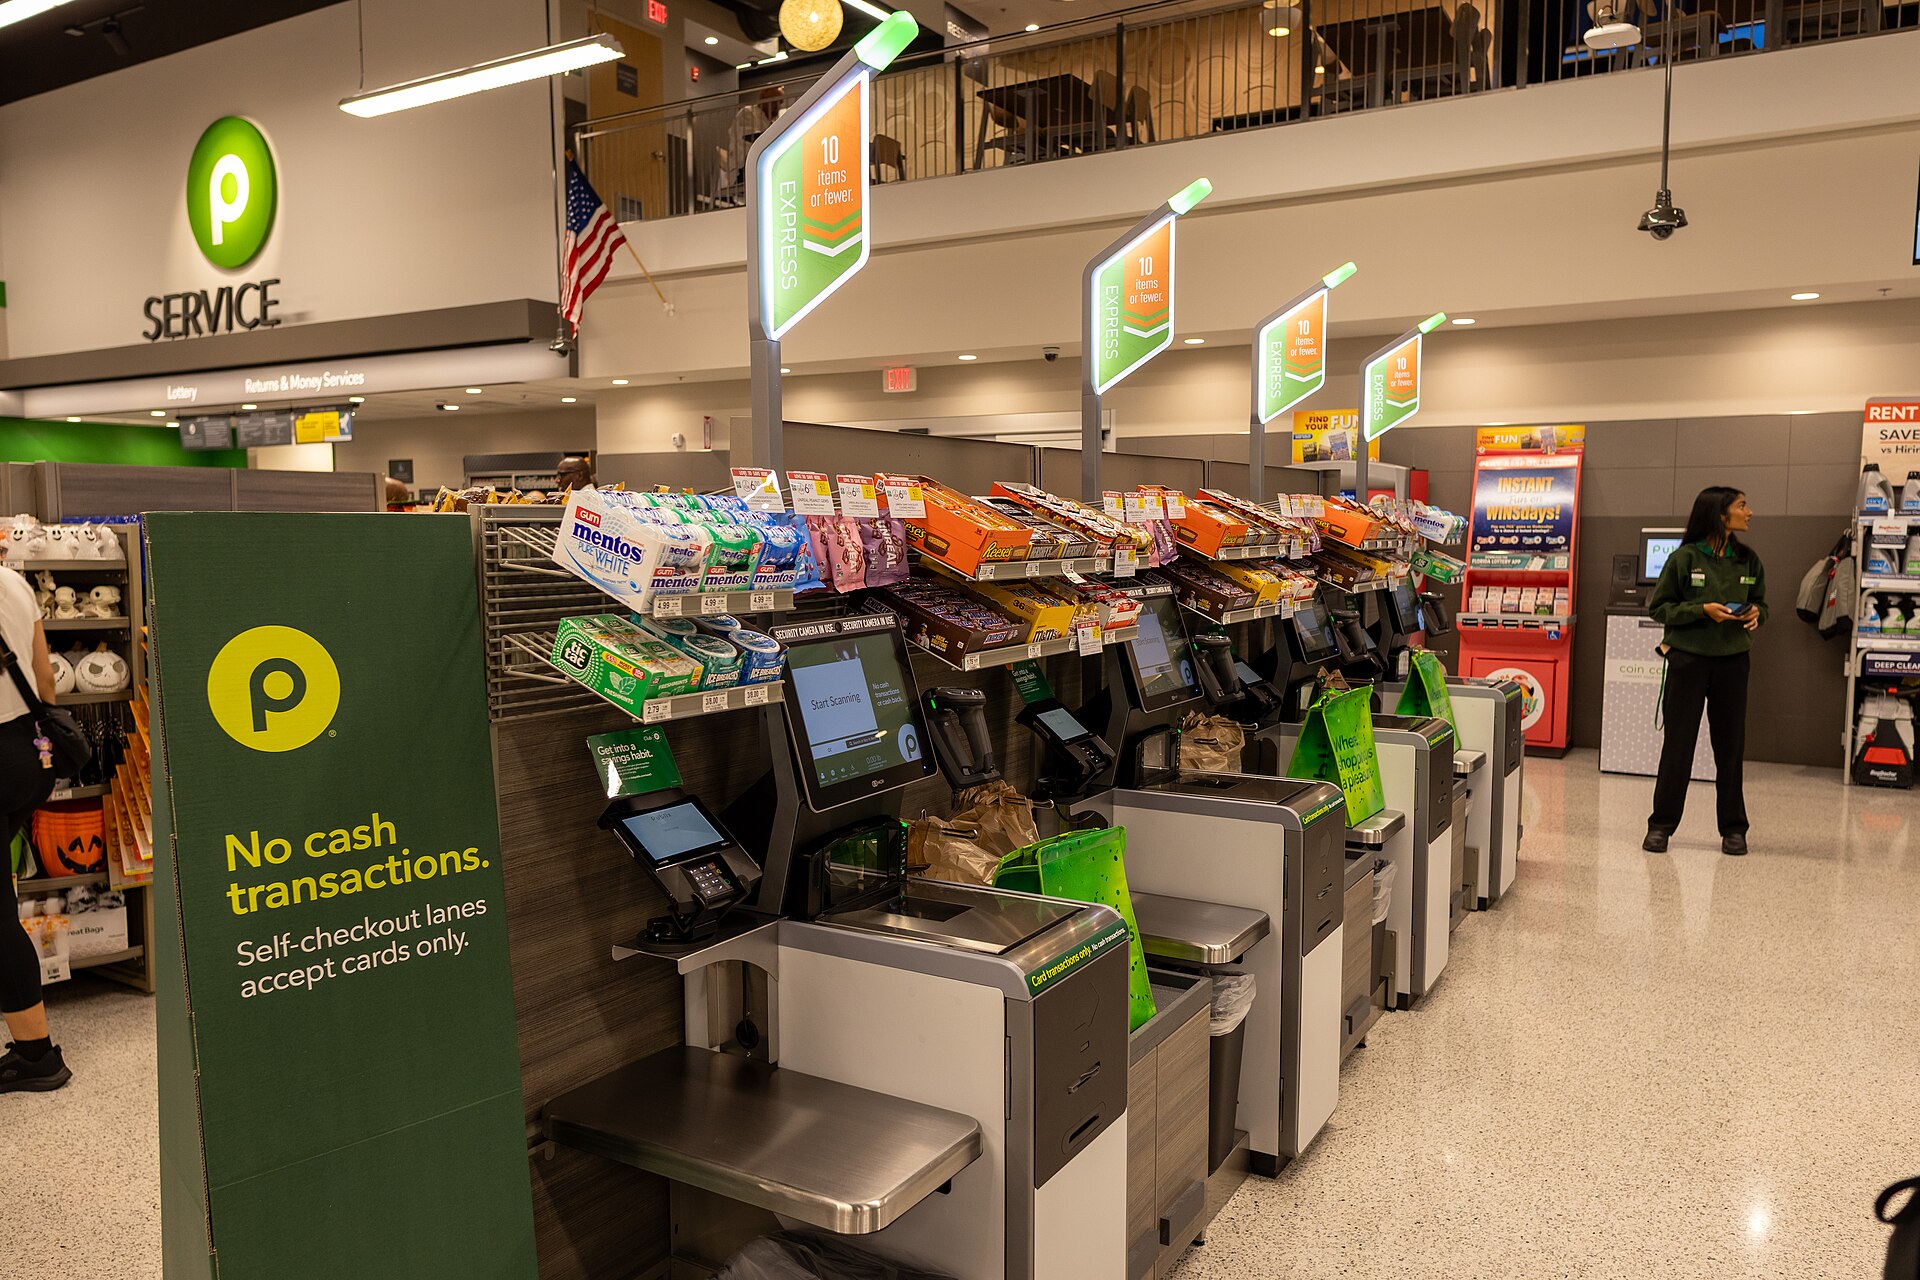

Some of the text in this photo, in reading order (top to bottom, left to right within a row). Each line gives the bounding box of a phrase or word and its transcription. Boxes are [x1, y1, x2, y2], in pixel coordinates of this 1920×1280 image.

[821, 136, 839, 165] 10
[817, 168, 847, 187] items
[810, 187, 854, 207] or fewer.
[779, 180, 797, 290] EXPRESS
[1138, 256, 1153, 277] 10
[1135, 278, 1158, 291] items
[1129, 291, 1164, 305] or fewer.
[142, 278, 281, 341] SERVICE
[1105, 285, 1119, 360] EXPRESS
[1298, 319, 1310, 336] 10
[1295, 336, 1314, 347] items
[1290, 345, 1318, 357] or fewer.
[1270, 341, 1283, 399] EXPRESS
[1396, 357, 1407, 370] 10
[245, 370, 365, 394] Returns & Money Services
[887, 367, 911, 391] EXIT
[1394, 370, 1410, 379] items
[167, 385, 198, 402] Lottery
[1373, 374, 1384, 421] EXPRESS
[1309, 415, 1329, 424] FIND
[1869, 406, 1919, 420] RENT
[1494, 434, 1518, 444] FUN
[1880, 429, 1920, 440] SAVE
[1497, 477, 1554, 494] INSTANT
[1486, 504, 1561, 524] WINSdays!
[1414, 516, 1445, 529] mentos
[572, 522, 642, 562] mentos
[877, 520, 897, 569] UNREAL
[981, 541, 1014, 559] Reese's
[578, 541, 630, 577] PURE WHITE
[651, 576, 699, 588] mentos
[704, 574, 749, 586] mentos
[754, 573, 795, 584] mentos
[657, 601, 670, 610] 4.99
[704, 598, 717, 607] 4.99
[753, 595, 765, 604] 4.99
[1012, 599, 1026, 611] 36
[843, 619, 863, 631] SECURITY
[863, 618, 880, 629] CAMERA
[880, 616, 886, 627] IN
[775, 628, 799, 640] SECURITY
[799, 626, 818, 638] CAMERA
[818, 625, 824, 635] IN
[564, 647, 585, 668] tac
[571, 641, 589, 660] tic
[749, 665, 782, 680] ICE BREAKERS
[1619, 664, 1645, 675] coin
[1874, 661, 1895, 669] DEEP
[706, 669, 740, 686] ICE BREAKERS
[872, 681, 890, 690] No cash
[874, 688, 900, 699] transactions
[811, 692, 862, 711] Start Scanning
[647, 705, 660, 715] 2.79
[597, 745, 614, 756] Get
[613, 743, 630, 754] into
[601, 748, 654, 766] savings habit.
[1342, 778, 1348, 790] a
[225, 812, 398, 872] No cash
[225, 845, 491, 916] transactions.
[84, 926, 104, 935] Bags
[235, 898, 488, 968] Self-checkout lanes
[1091, 943, 1098, 951] No
[1098, 938, 1106, 949] cash
[240, 929, 471, 1000] accept cards only.
[1031, 945, 1093, 988] Card transactions only.
